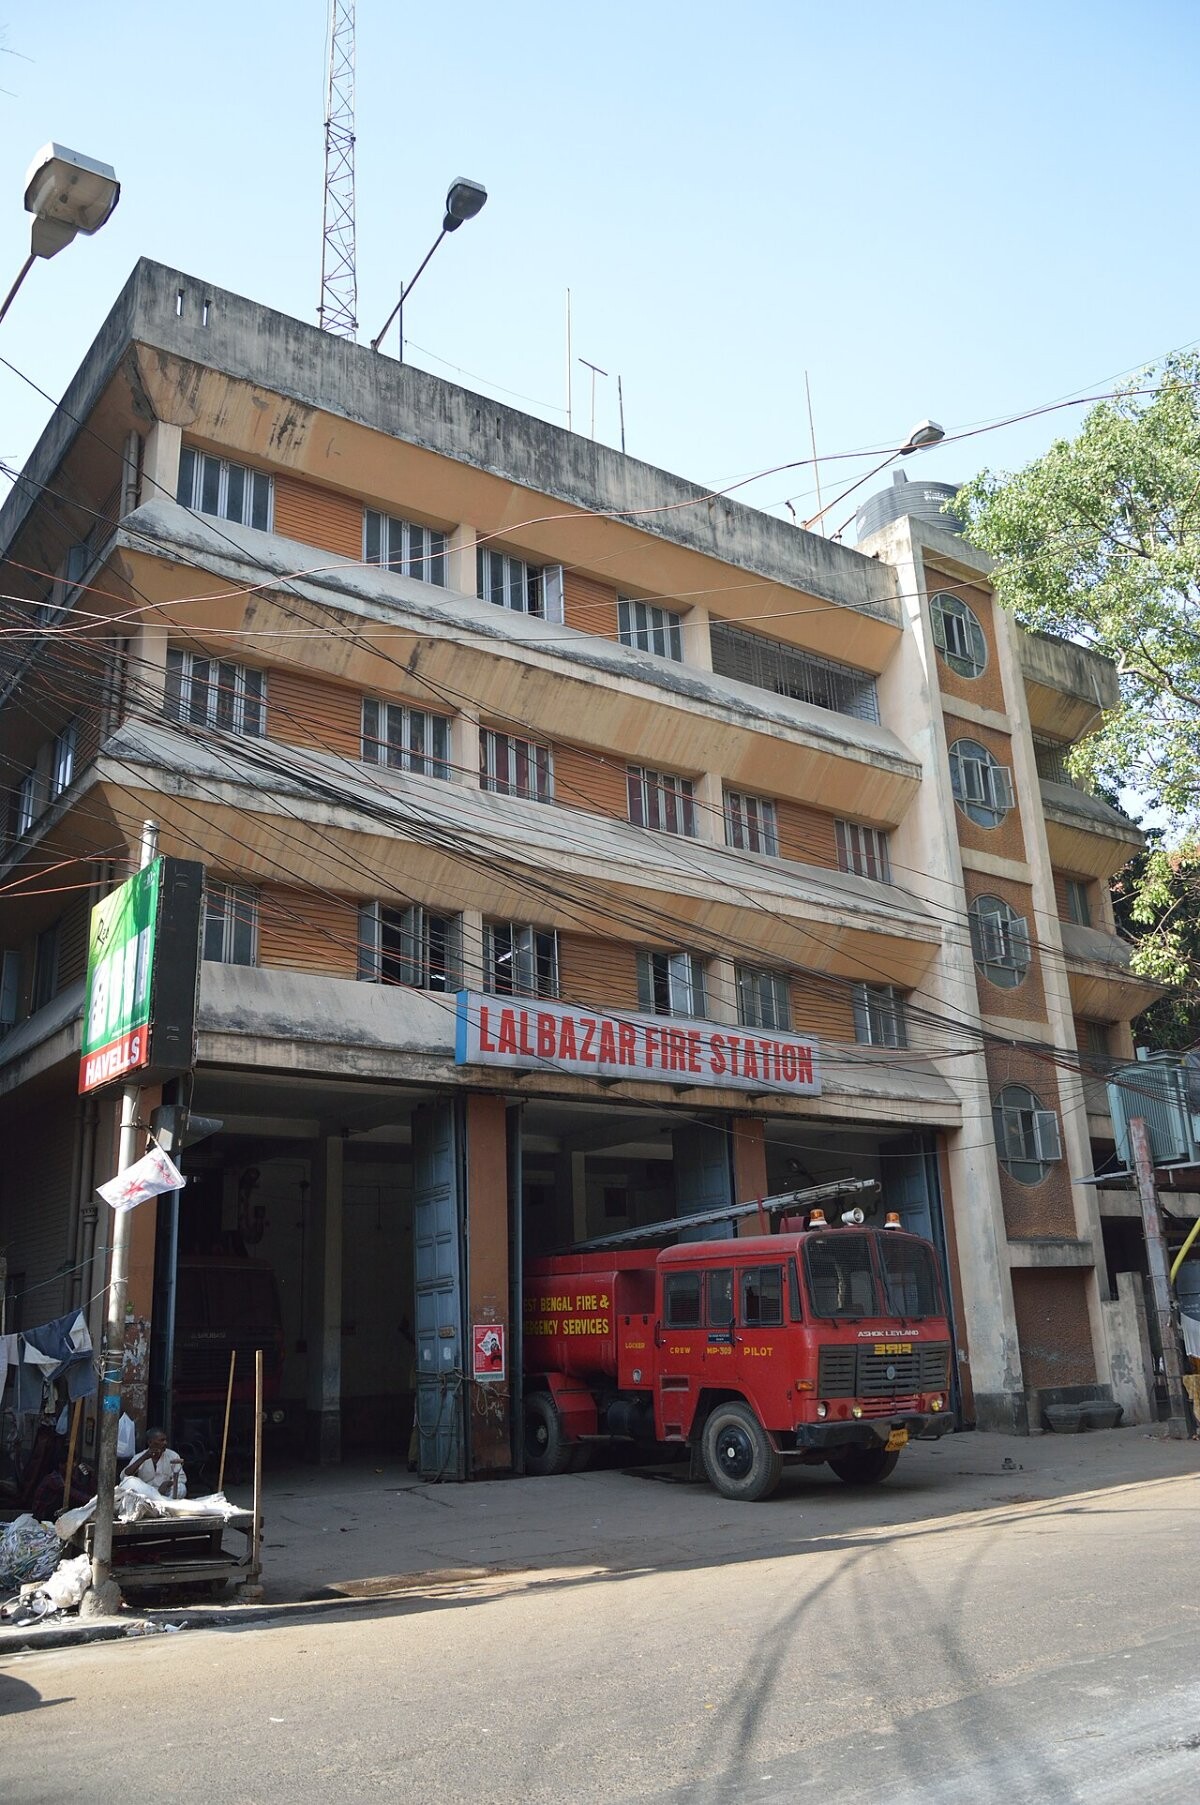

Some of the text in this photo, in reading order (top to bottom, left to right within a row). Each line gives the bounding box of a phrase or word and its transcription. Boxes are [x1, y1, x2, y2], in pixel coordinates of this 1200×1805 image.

[479, 1006, 814, 1084] LALBAZAR FIRE STATION
[85, 1036, 140, 1087] HAVELLS
[524, 1294, 610, 1312] EST BENGAL FIRE &
[524, 1318, 609, 1335] ERGENCY SERVICES
[857, 1329, 919, 1338] ASHOK LEYLAND
[743, 1347, 774, 1356] PILOT
